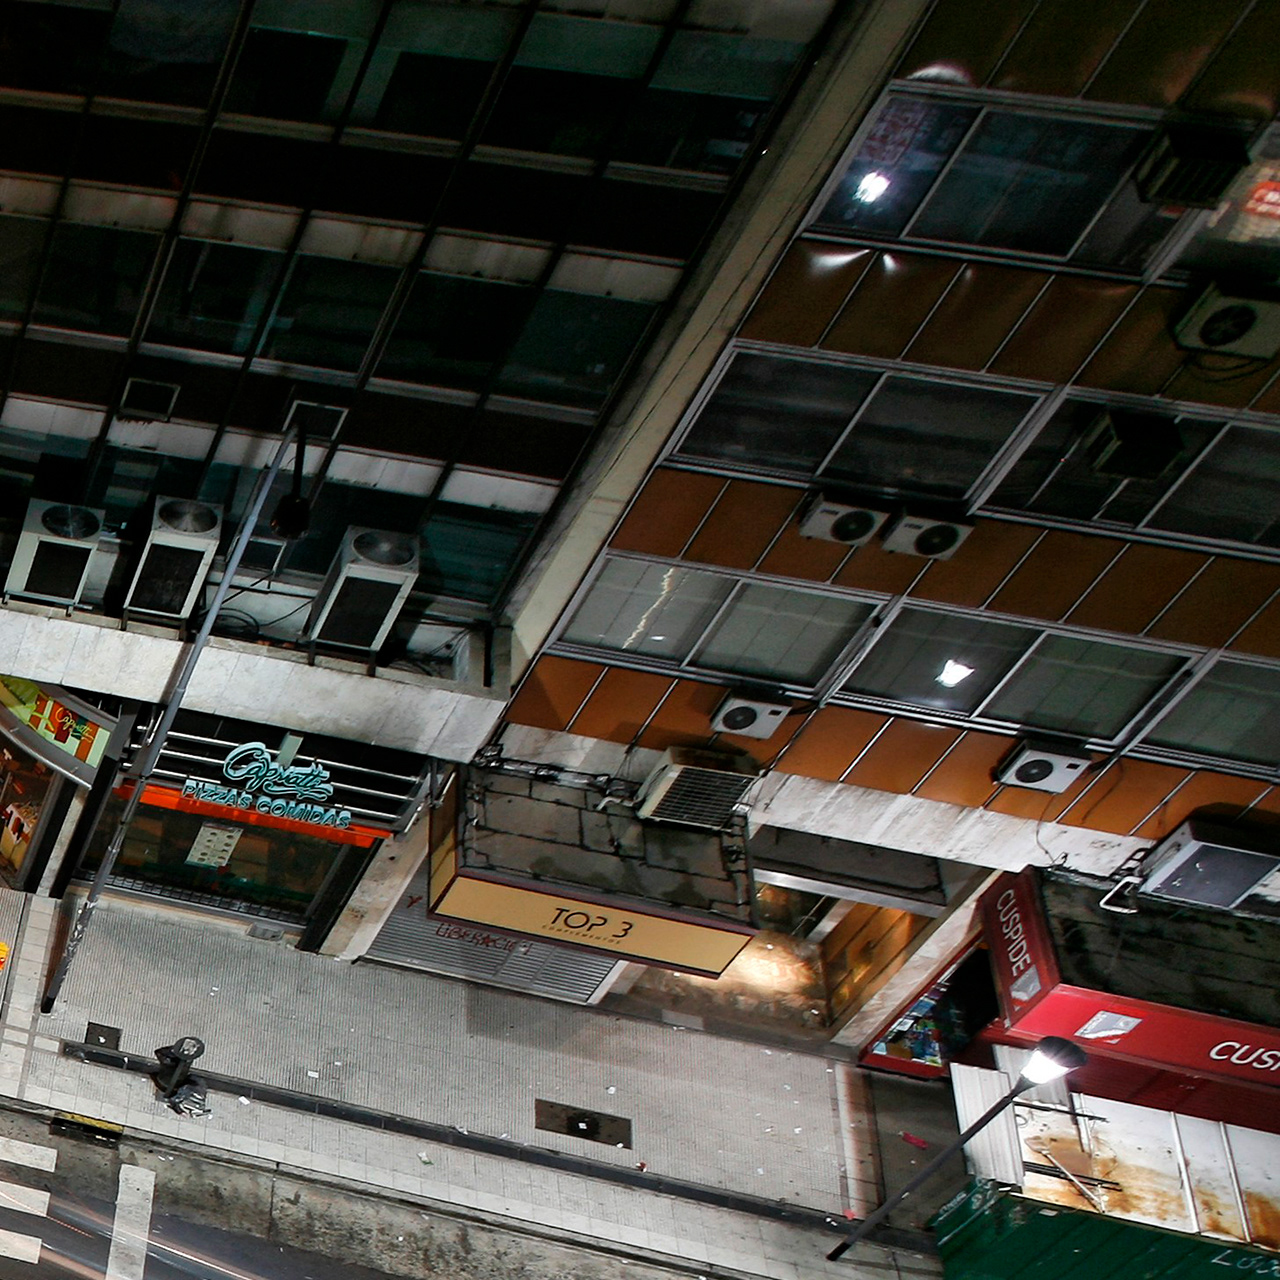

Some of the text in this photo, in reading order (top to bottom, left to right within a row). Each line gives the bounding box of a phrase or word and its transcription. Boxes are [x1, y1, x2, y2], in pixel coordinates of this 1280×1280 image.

[181, 778, 352, 830] PIZZAS COMIDAS
[550, 907, 634, 938] TOP 3
[996, 888, 1032, 977] CUSPIDE
